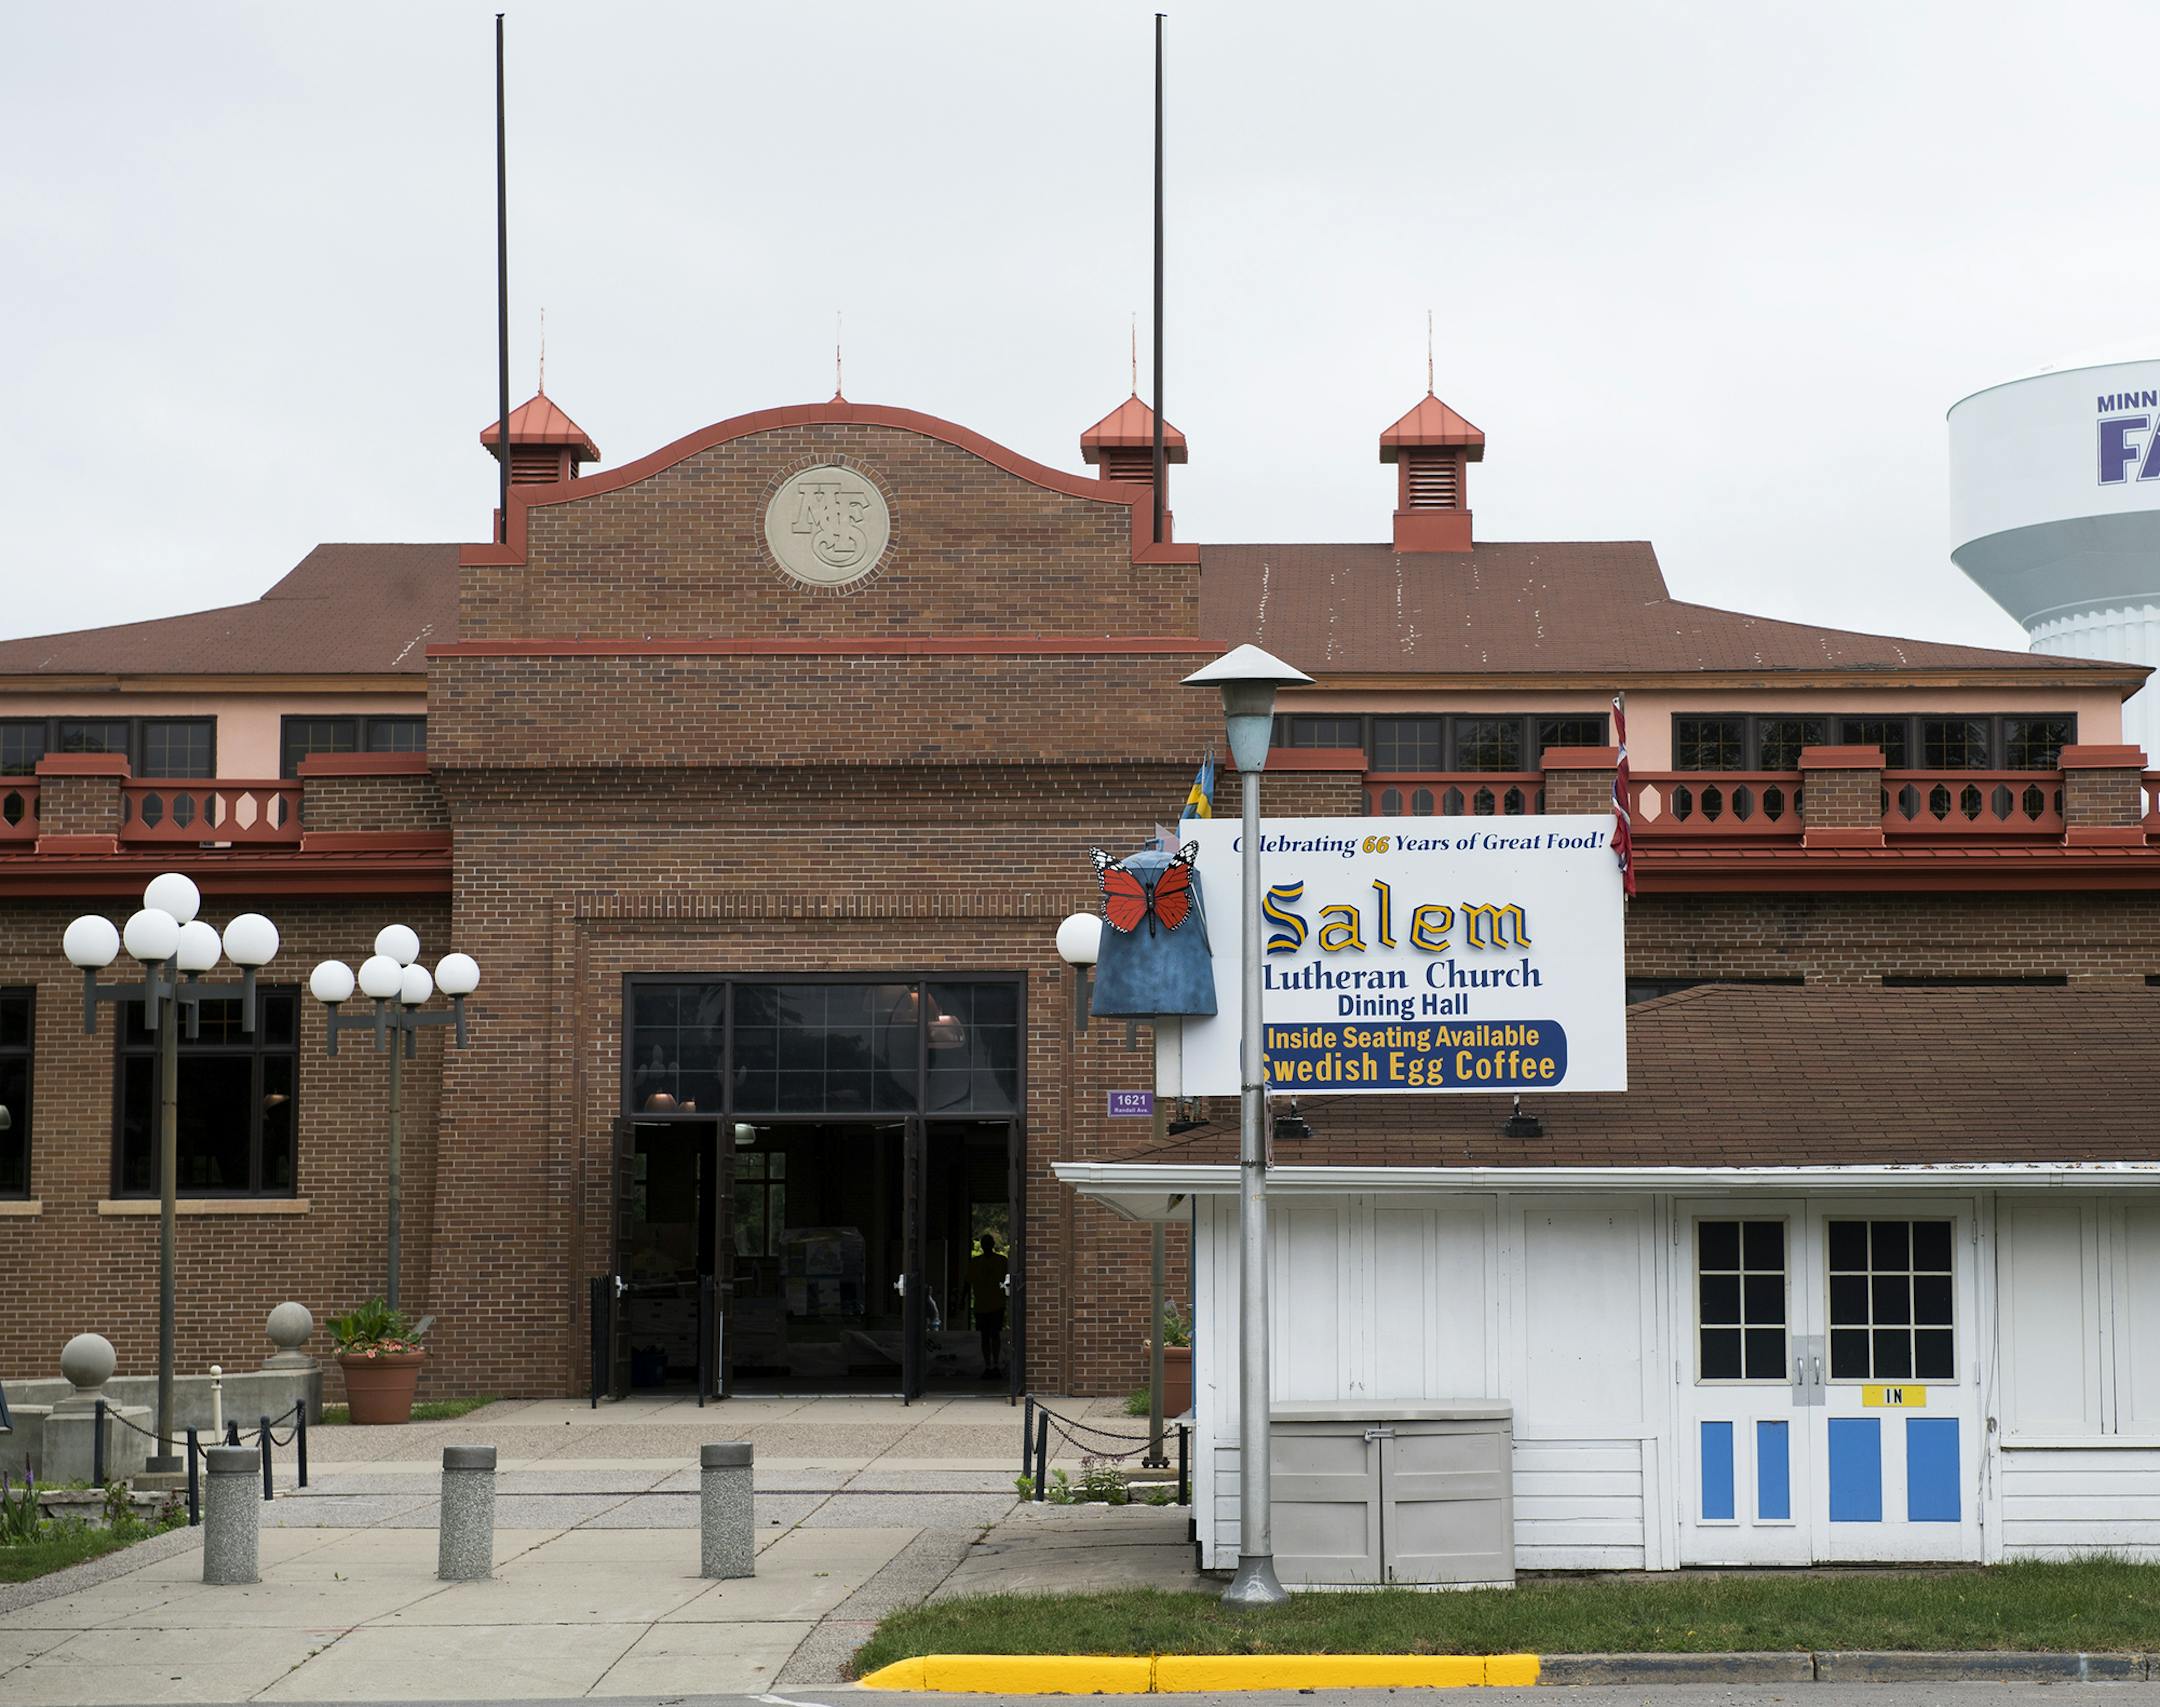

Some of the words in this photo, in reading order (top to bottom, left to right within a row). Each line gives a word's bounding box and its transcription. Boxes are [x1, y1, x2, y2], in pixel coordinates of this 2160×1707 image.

[1232, 834, 1358, 859] Clebrating
[1362, 835, 1391, 854] 66
[1396, 834, 1450, 851] Years
[1456, 832, 1481, 851] of
[1483, 833, 1542, 851] Great
[1547, 831, 1605, 850] Food!
[1262, 879, 1532, 956] Salem
[1262, 960, 1409, 991] Lutheran
[1426, 958, 1543, 989] Church
[1338, 994, 1416, 1021] Dining
[1422, 993, 1469, 1015] Hall
[1268, 1026, 1337, 1049] Inside
[1343, 1026, 1432, 1053] Seating
[1434, 1024, 1540, 1047] Available
[1389, 1051, 1444, 1087] Egg
[1455, 1050, 1556, 1081] Coffee
[1118, 1094, 1146, 1106] 1621
[1886, 1388, 1903, 1404] IN
